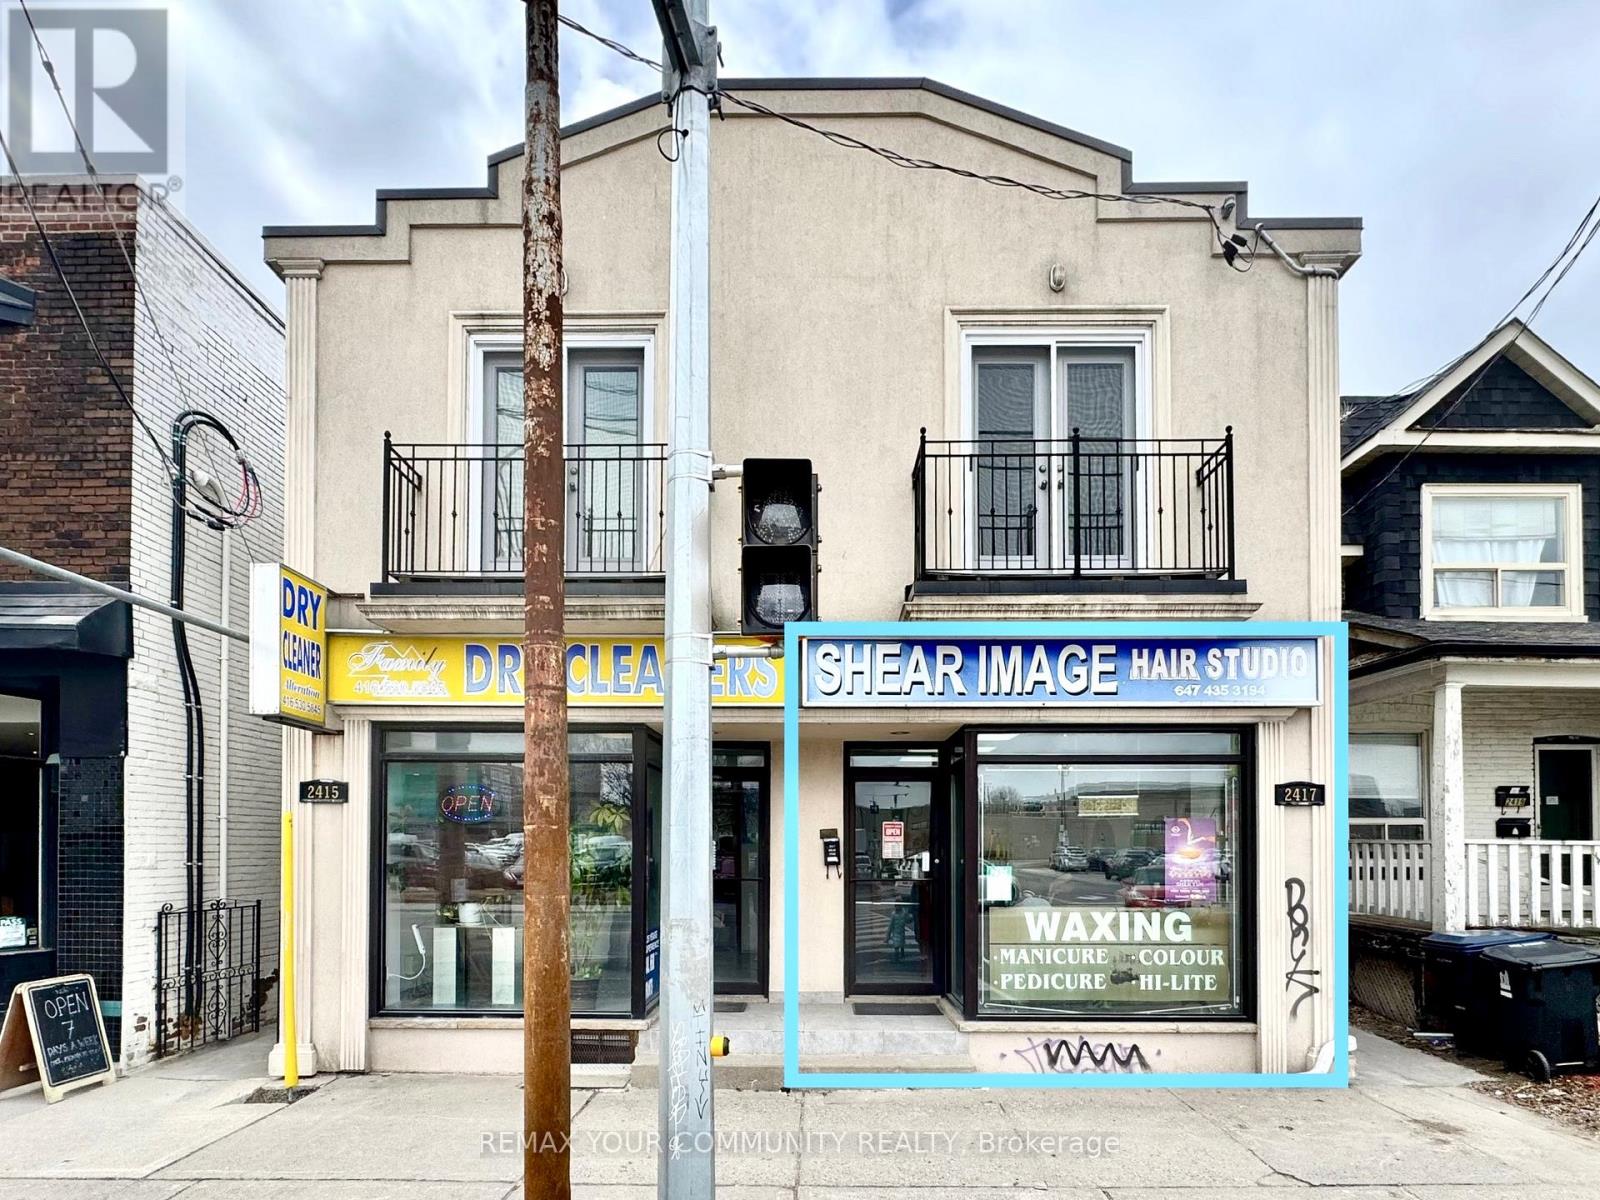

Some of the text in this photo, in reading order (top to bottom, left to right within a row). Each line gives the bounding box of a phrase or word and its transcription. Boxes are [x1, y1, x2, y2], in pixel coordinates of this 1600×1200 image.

[282, 576, 322, 630] DRY
[283, 630, 321, 679] CLEANER
[463, 643, 525, 695] DR
[566, 643, 779, 698] CLEAERS
[815, 643, 1308, 696] SHEAR IMAGE HAIR STUDIO
[1174, 684, 1200, 696] 647
[1204, 684, 1229, 696] 435
[307, 785, 339, 799] 2415
[442, 795, 494, 812] OPEN
[1284, 788, 1317, 801] 2417
[1024, 911, 1192, 942] WAXING
[1000, 948, 1225, 966] MANICURE COLOUR
[1000, 973, 1217, 991] PEDICURE HI-LITE
[44, 991, 90, 1019] OPEN
[61, 1019, 75, 1040] 7
[46, 1042, 69, 1058] DAYS
[77, 1033, 99, 1049] WEEK
